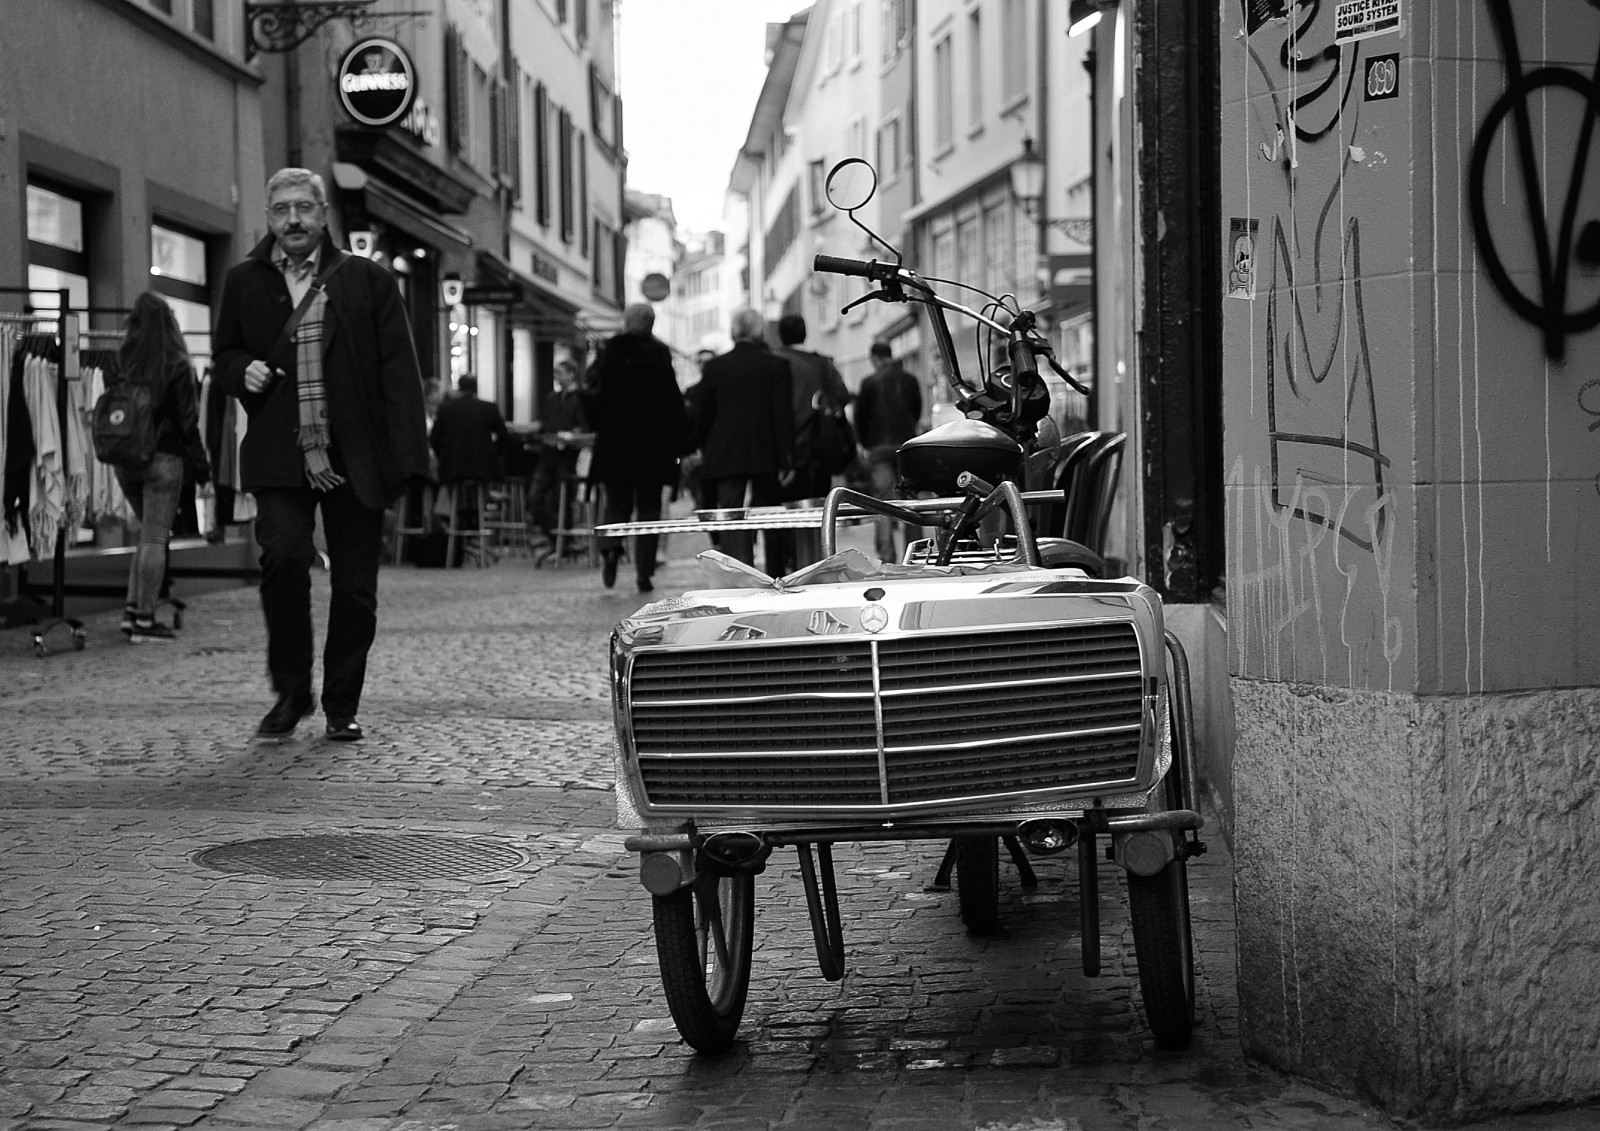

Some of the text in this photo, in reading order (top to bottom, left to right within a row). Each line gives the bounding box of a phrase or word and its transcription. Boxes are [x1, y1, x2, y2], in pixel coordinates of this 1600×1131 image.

[1337, 0, 1370, 17] JUSTICE
[1337, 3, 1398, 28] SOUND SYSTEM
